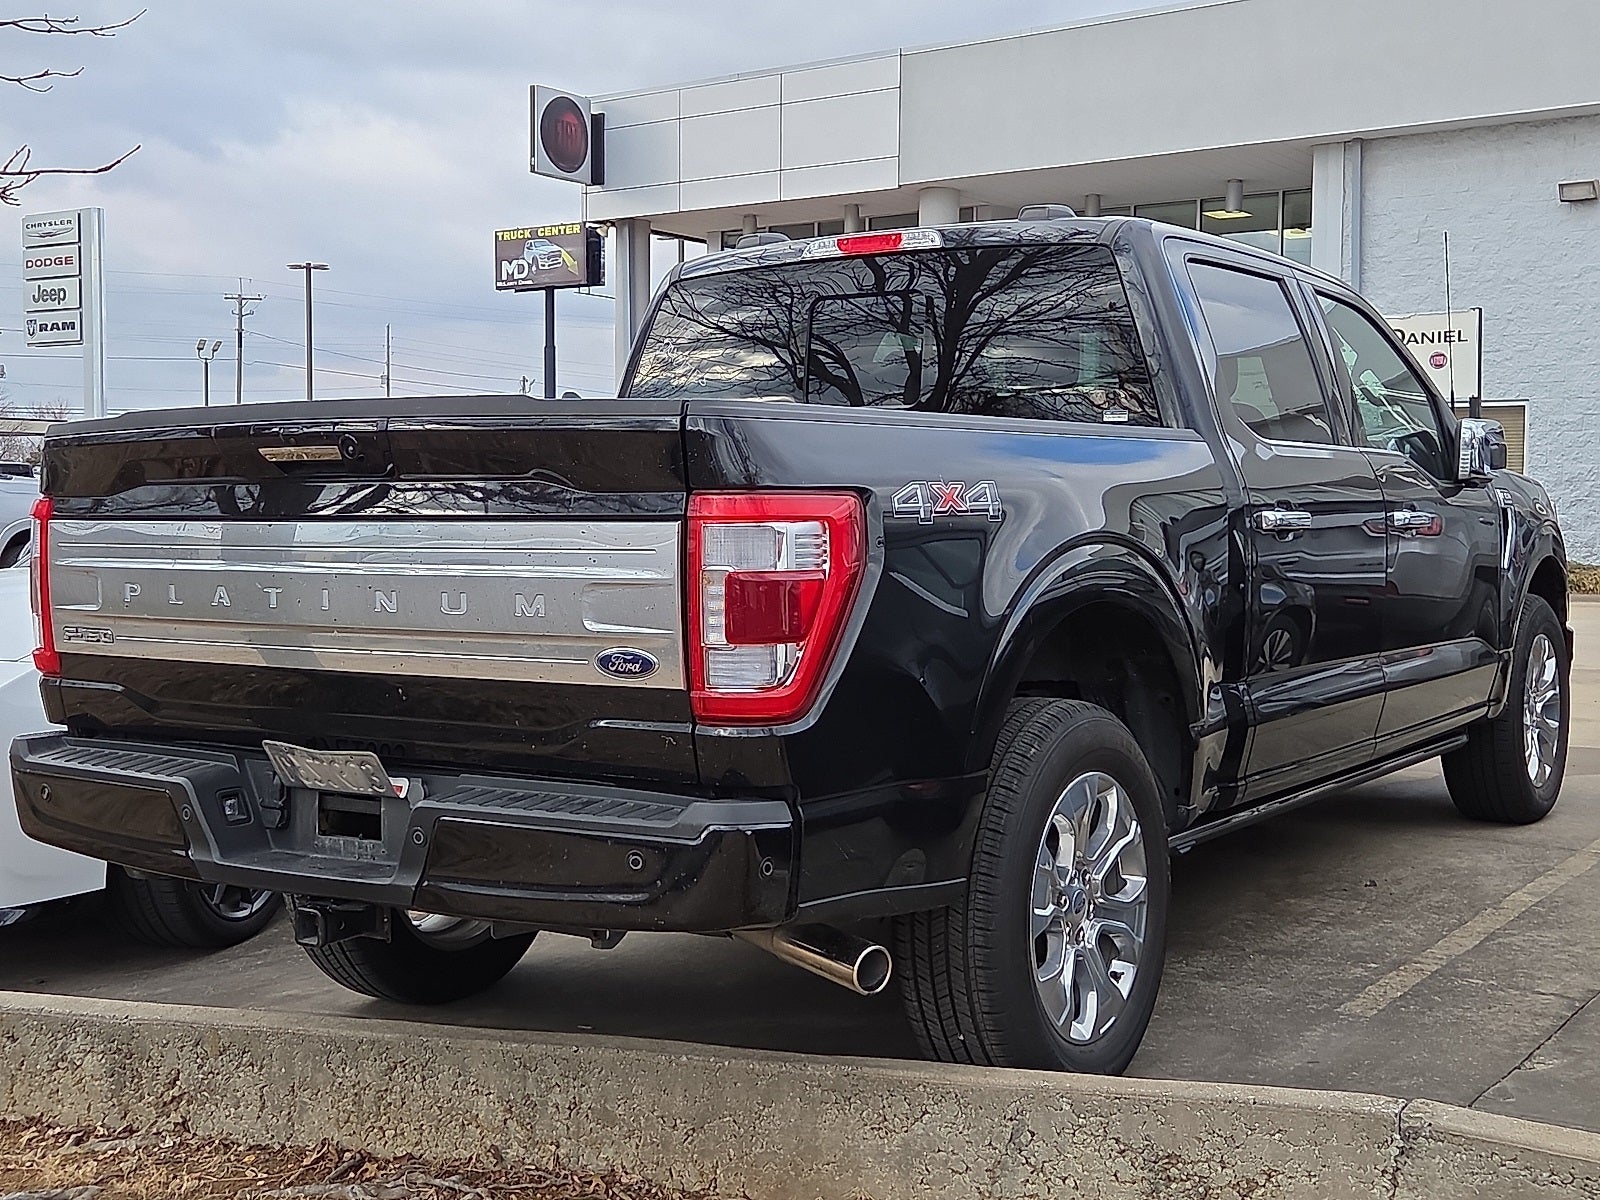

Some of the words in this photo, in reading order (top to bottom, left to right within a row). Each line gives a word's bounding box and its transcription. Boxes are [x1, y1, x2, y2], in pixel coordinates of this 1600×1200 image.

[25, 219, 73, 230] CHRYSLER
[496, 229, 532, 241] TRUCK
[537, 224, 581, 237] CENTER
[25, 255, 74, 269] DODGE
[32, 284, 67, 306] Jeep
[38, 321, 76, 333] RAM
[123, 582, 546, 618] PLATINUM
[608, 653, 643, 673] Ford
